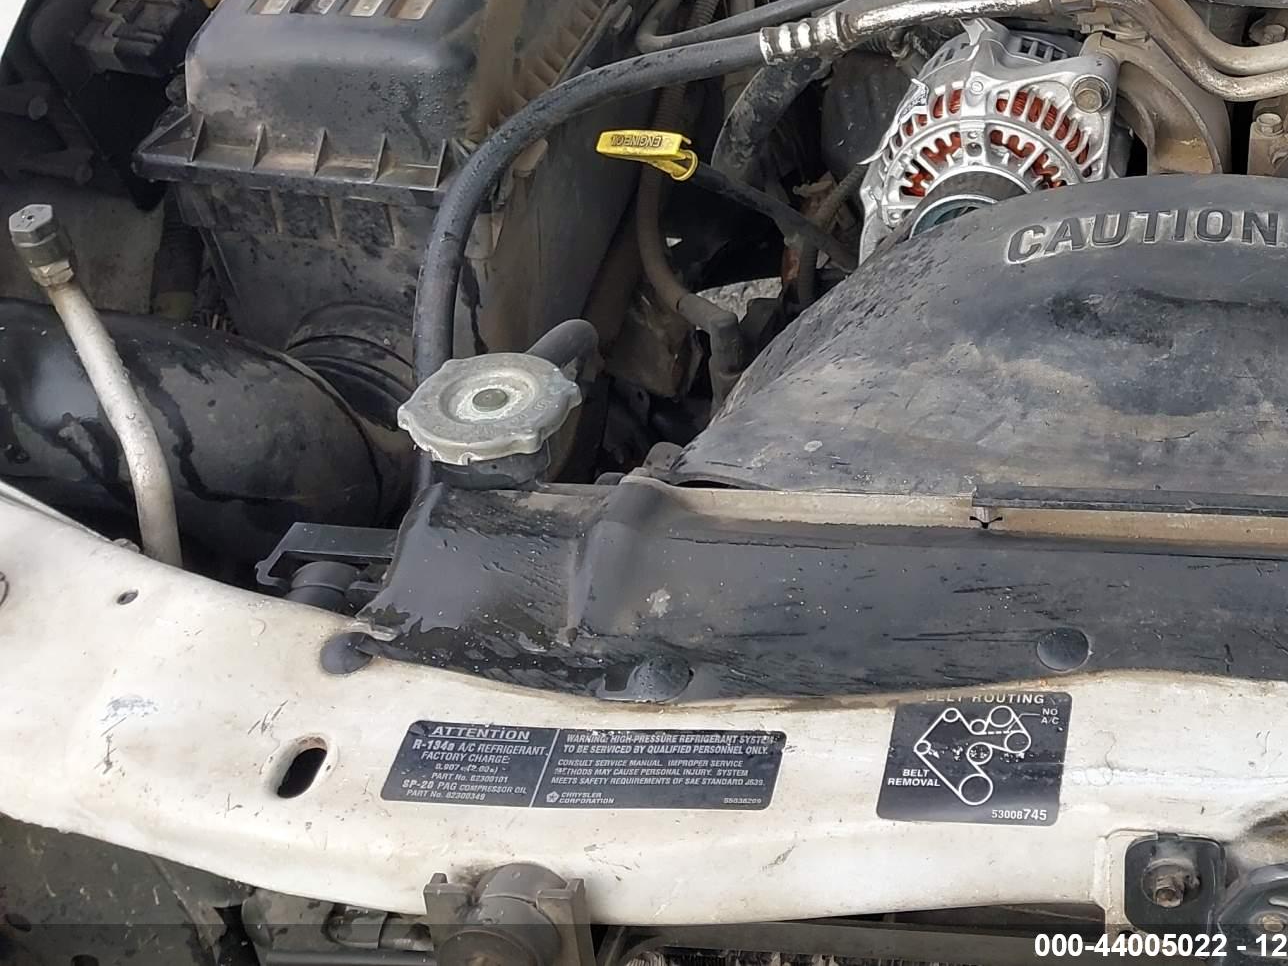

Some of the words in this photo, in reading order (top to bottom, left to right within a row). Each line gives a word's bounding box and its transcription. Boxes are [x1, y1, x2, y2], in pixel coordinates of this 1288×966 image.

[624, 134, 662, 147] ENGINE
[1006, 208, 1281, 264] CAUTION
[971, 693, 1045, 704] ROUTING
[1042, 708, 1058, 716] NO
[1040, 716, 1060, 725] A/C
[431, 725, 531, 740] ATTENTION
[610, 734, 678, 744] HIGH-PRESSURE
[679, 734, 737, 744] REFRIGERANT
[412, 738, 455, 751] R-134a
[457, 742, 476, 754] A/C
[477, 743, 547, 756] REFRIGERANT
[563, 744, 575, 753] TO
[576, 744, 589, 754] BE
[589, 744, 632, 754] SERVICED
[633, 745, 646, 754] BY
[646, 745, 691, 754] QUALIFIED
[692, 745, 743, 754] PERSONNEL
[745, 745, 768, 755] ONLY.
[420, 750, 467, 762] FACTORY
[468, 753, 511, 764] CHARGE:
[557, 758, 594, 766] CONSULT
[594, 759, 627, 767] SERVICE
[667, 759, 709, 767] IMPROPER
[709, 760, 744, 768] SERVICE
[431, 772, 453, 780] PART
[455, 773, 468, 781] No.
[613, 768, 640, 776] CAUSE
[640, 768, 681, 776] PERSONAL
[716, 769, 749, 777] SYSTEM
[902, 768, 930, 777] BELT
[402, 778, 435, 789] SP-20
[437, 781, 458, 791] PAG
[459, 784, 513, 794] COMPRESSOR
[514, 786, 528, 795] OIL
[578, 777, 608, 785] SAFETY
[609, 777, 671, 785] REQUIREMENTS
[672, 777, 684, 785] OF
[701, 778, 743, 786] STANDARD
[887, 777, 941, 788] REMOVAL
[406, 789, 430, 797] PART
[991, 808, 1048, 821] 53008745
